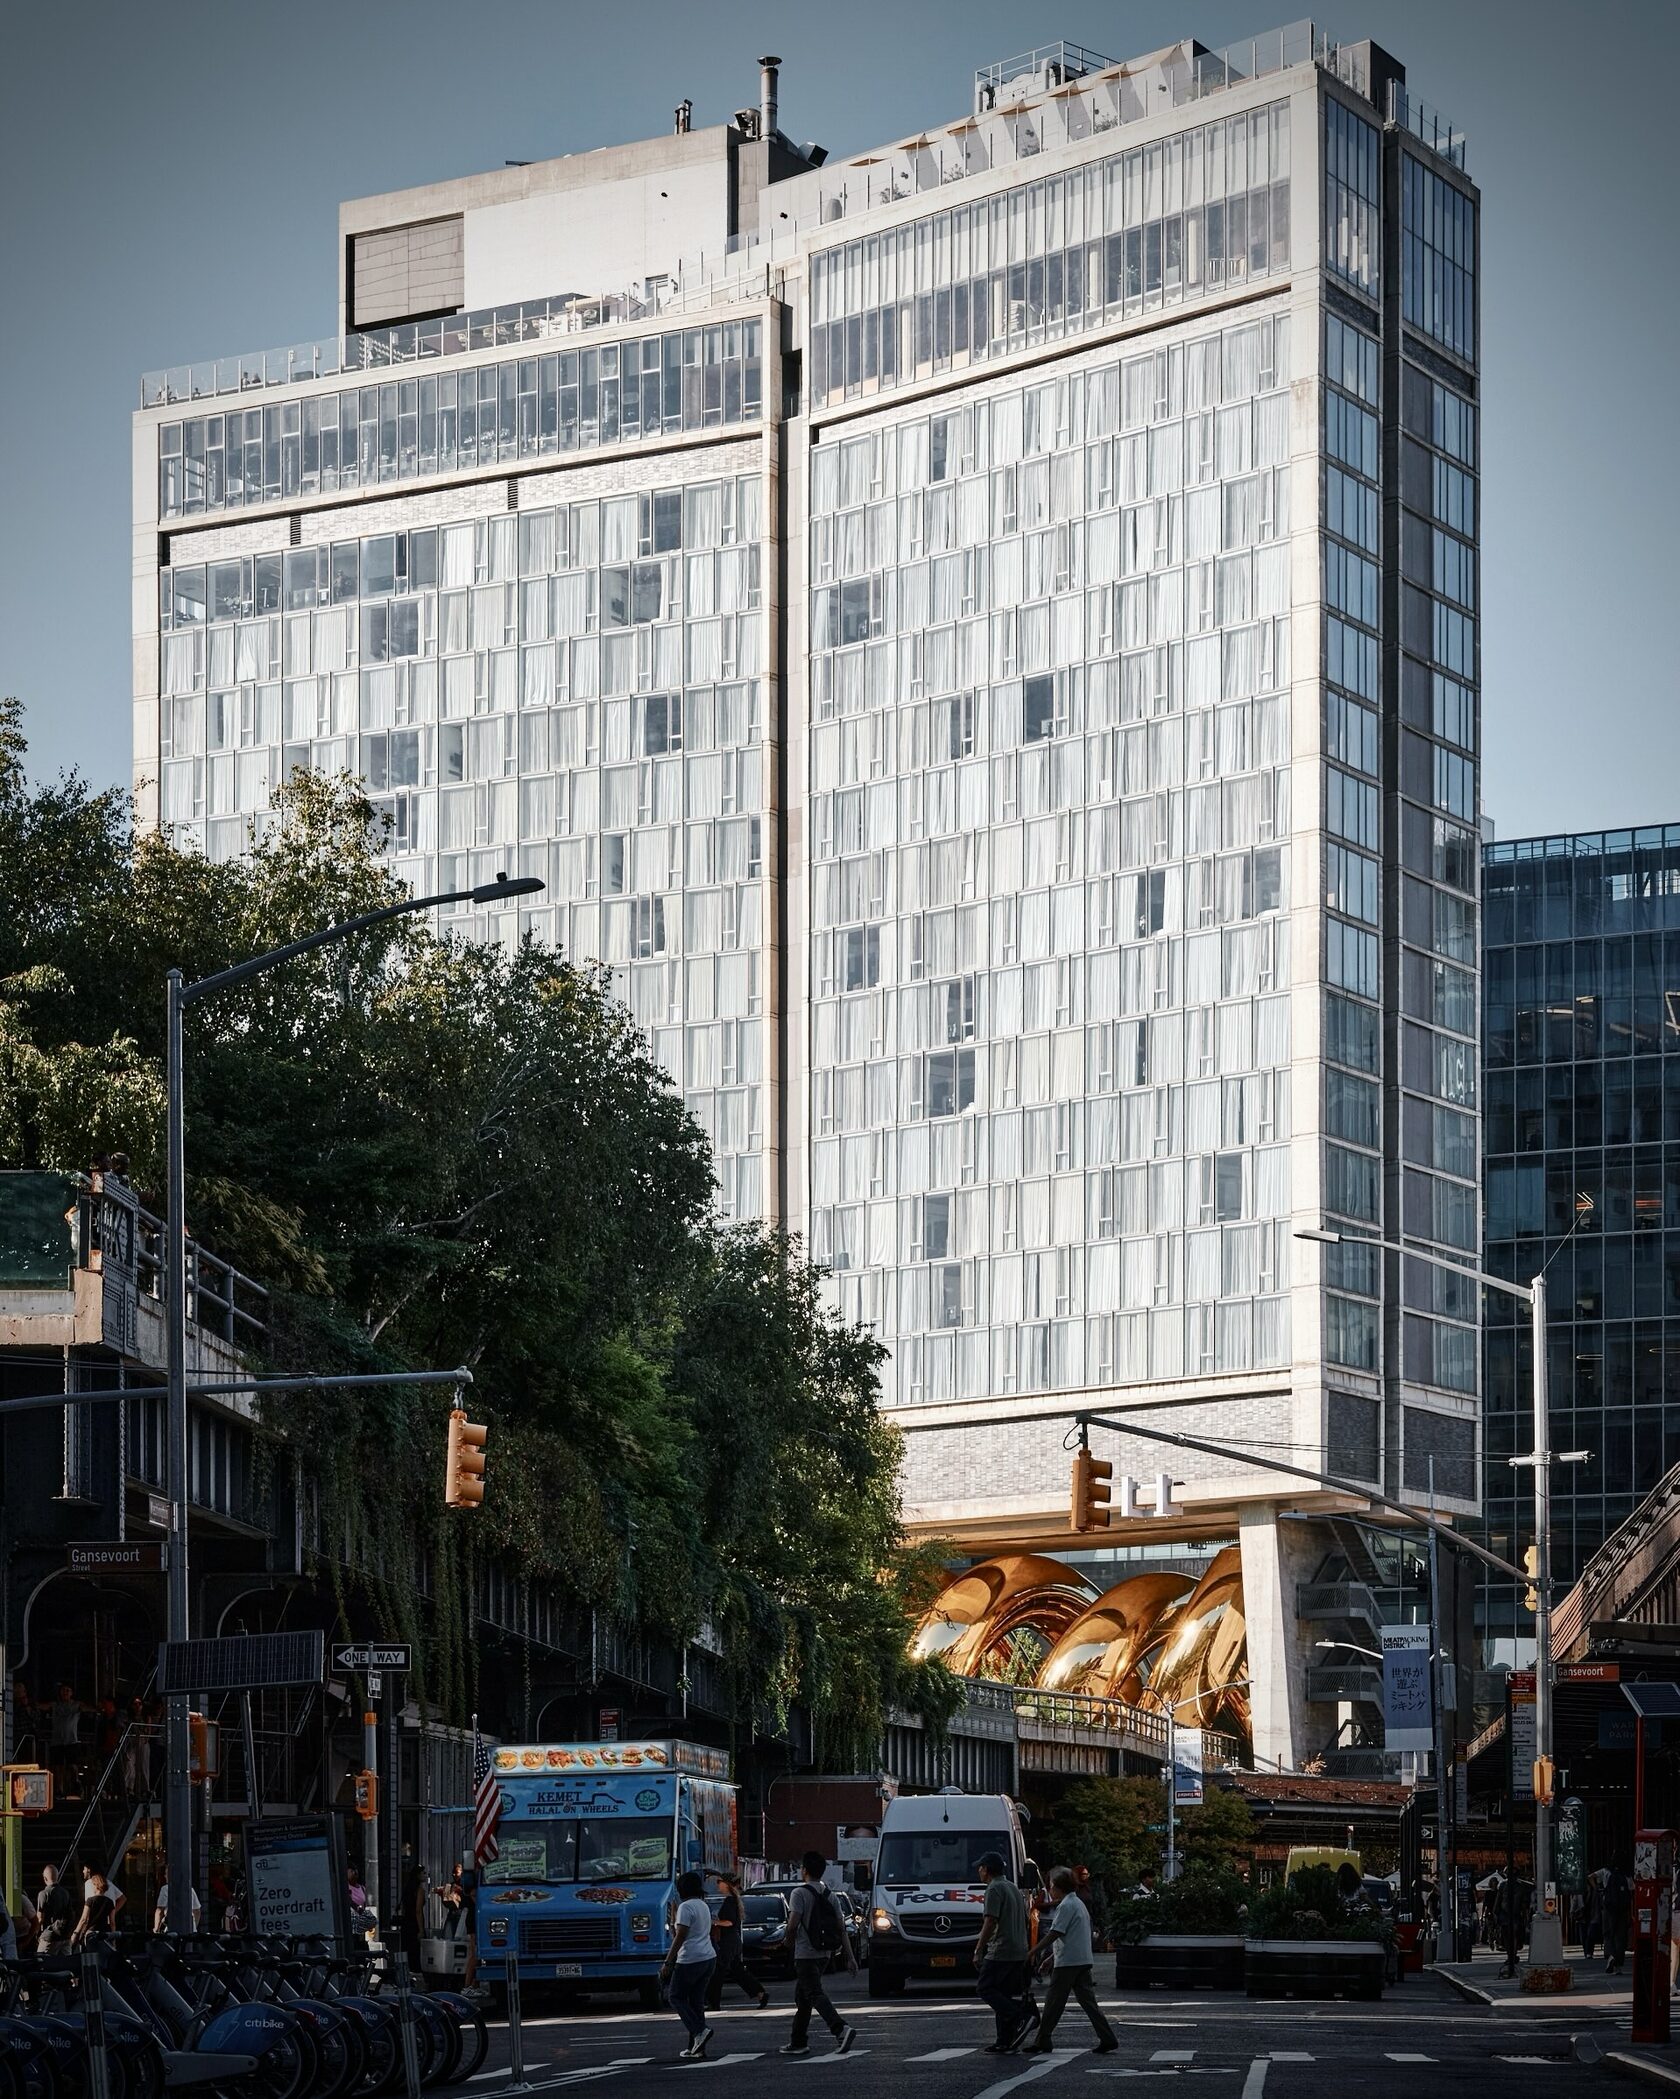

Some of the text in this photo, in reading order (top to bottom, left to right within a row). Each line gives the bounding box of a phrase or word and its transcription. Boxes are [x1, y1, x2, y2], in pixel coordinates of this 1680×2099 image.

[71, 1549, 141, 1562] Gansevoort
[344, 1652, 400, 1663] ONE WAY
[1557, 1666, 1604, 1676] Gansevoort
[536, 1791, 582, 1802] KEMET
[528, 1806, 561, 1815] HALAL
[582, 1804, 619, 1813] WHEELS
[258, 1887, 291, 1900] Zero
[896, 1890, 985, 1906] FedEx
[260, 1898, 325, 1916] overdraft
[261, 1919, 290, 1932] fees
